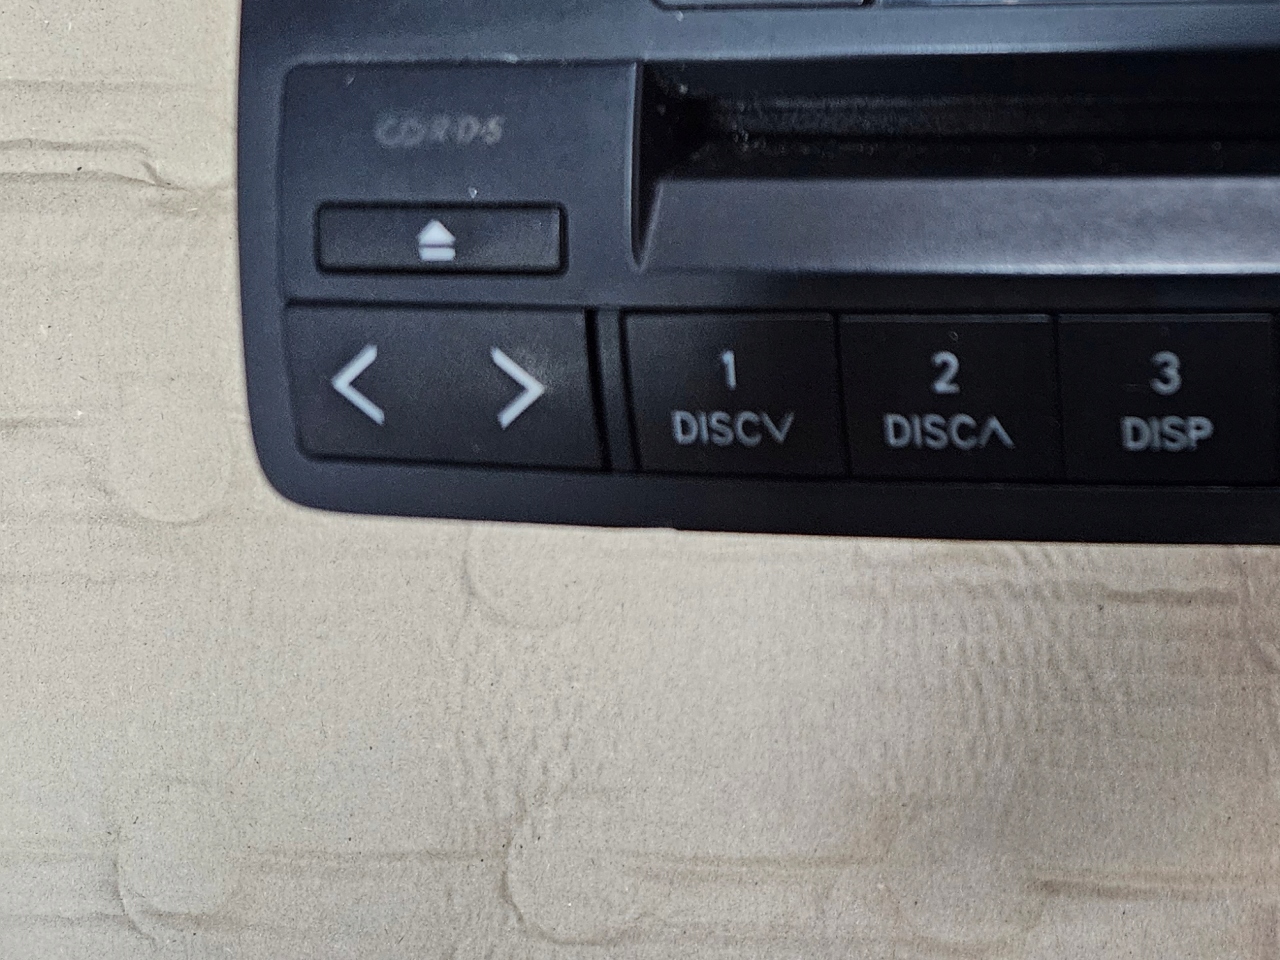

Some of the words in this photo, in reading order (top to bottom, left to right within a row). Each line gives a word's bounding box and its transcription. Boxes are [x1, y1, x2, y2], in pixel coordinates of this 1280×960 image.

[722, 349, 737, 391] 1
[930, 351, 960, 395] 2
[1149, 350, 1182, 395] 3
[1120, 416, 1215, 452] DISP
